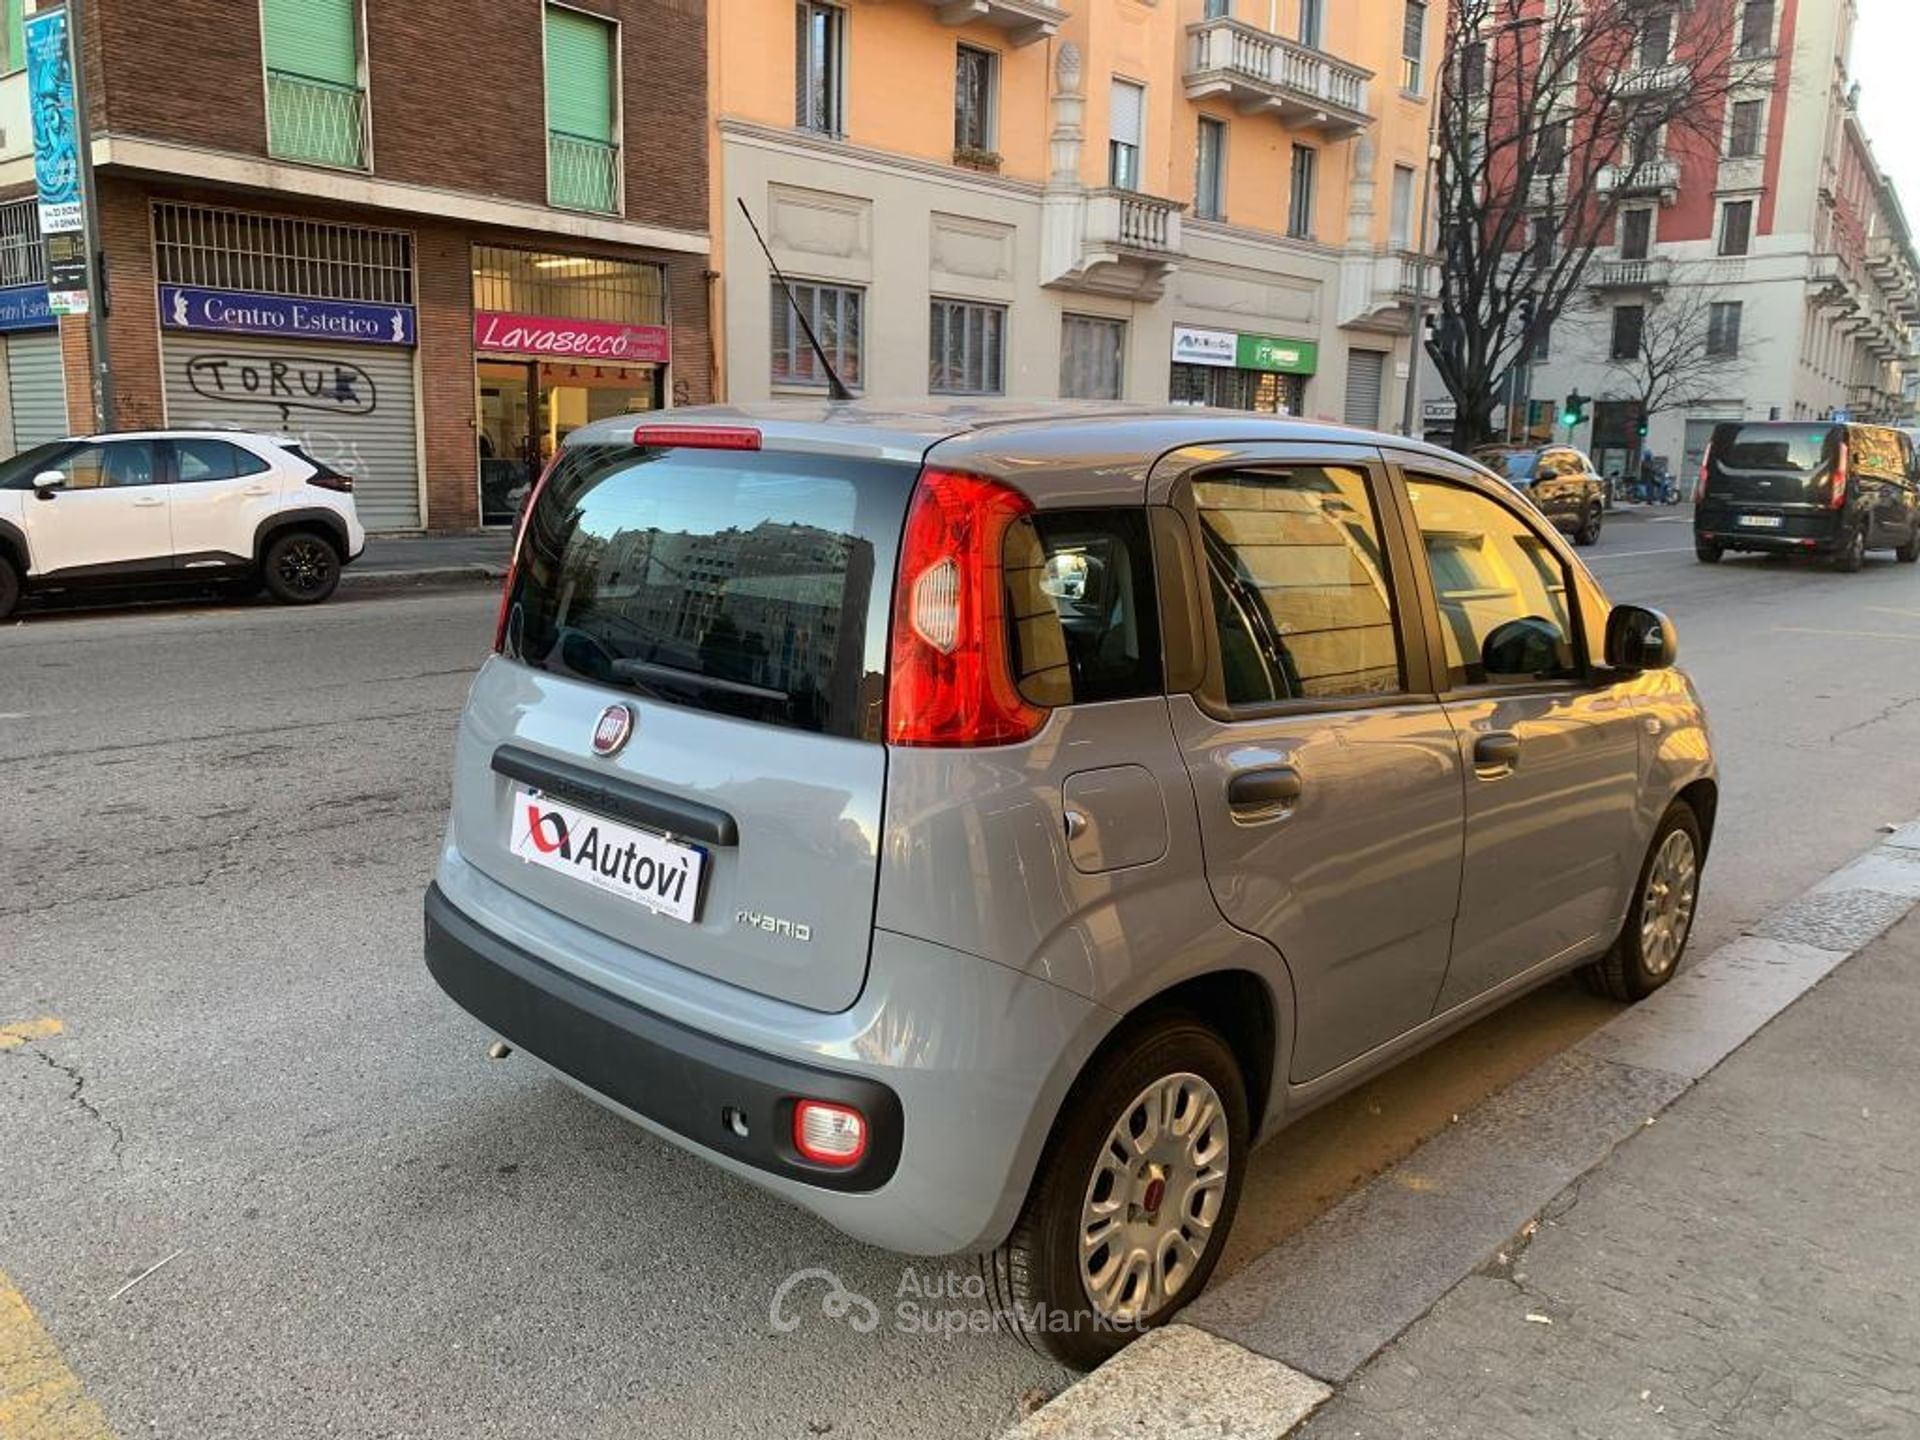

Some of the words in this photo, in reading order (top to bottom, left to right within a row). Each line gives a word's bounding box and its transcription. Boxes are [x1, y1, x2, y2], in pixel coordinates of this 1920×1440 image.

[204, 298, 285, 328] Centro
[292, 306, 379, 335] Estetico
[482, 318, 627, 355] Lavasecco
[574, 826, 689, 904] Autovì
